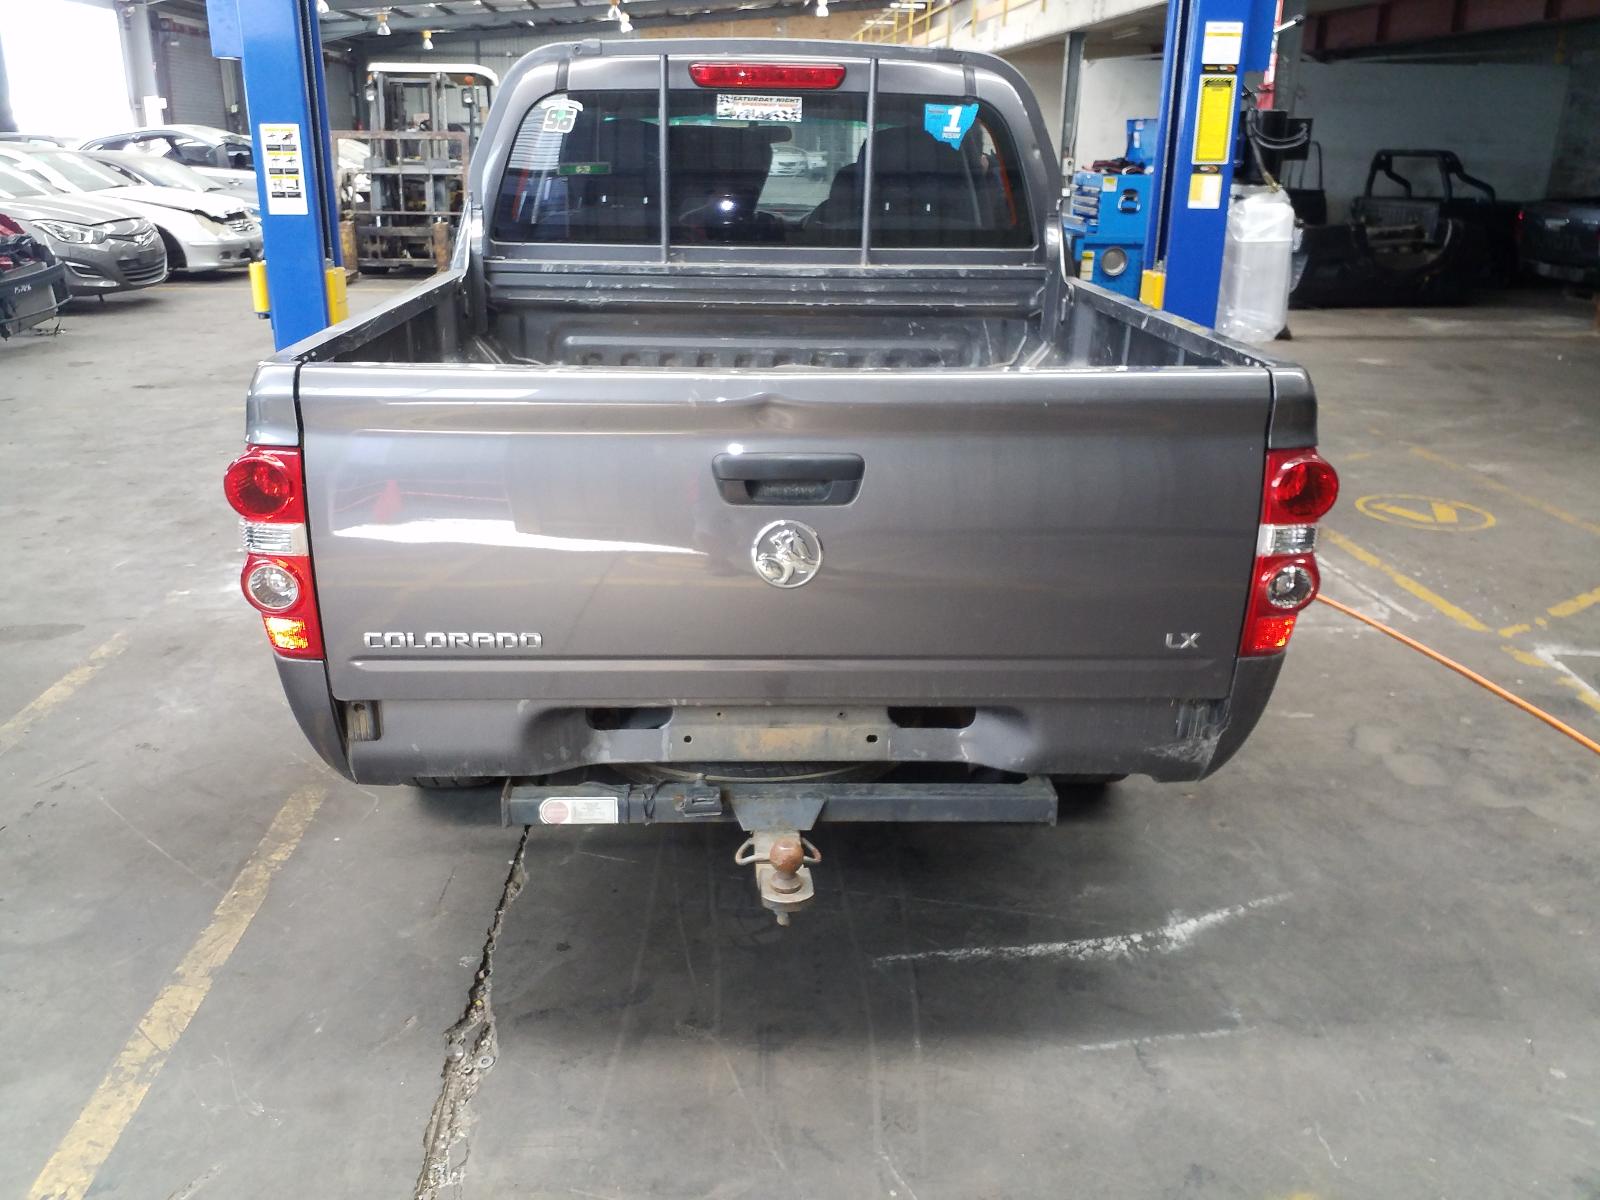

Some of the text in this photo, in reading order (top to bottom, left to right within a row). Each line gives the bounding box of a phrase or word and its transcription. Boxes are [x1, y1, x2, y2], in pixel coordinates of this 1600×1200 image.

[942, 105, 963, 133] 1
[363, 631, 543, 649] COLORADO
[1165, 632, 1201, 649] LX
